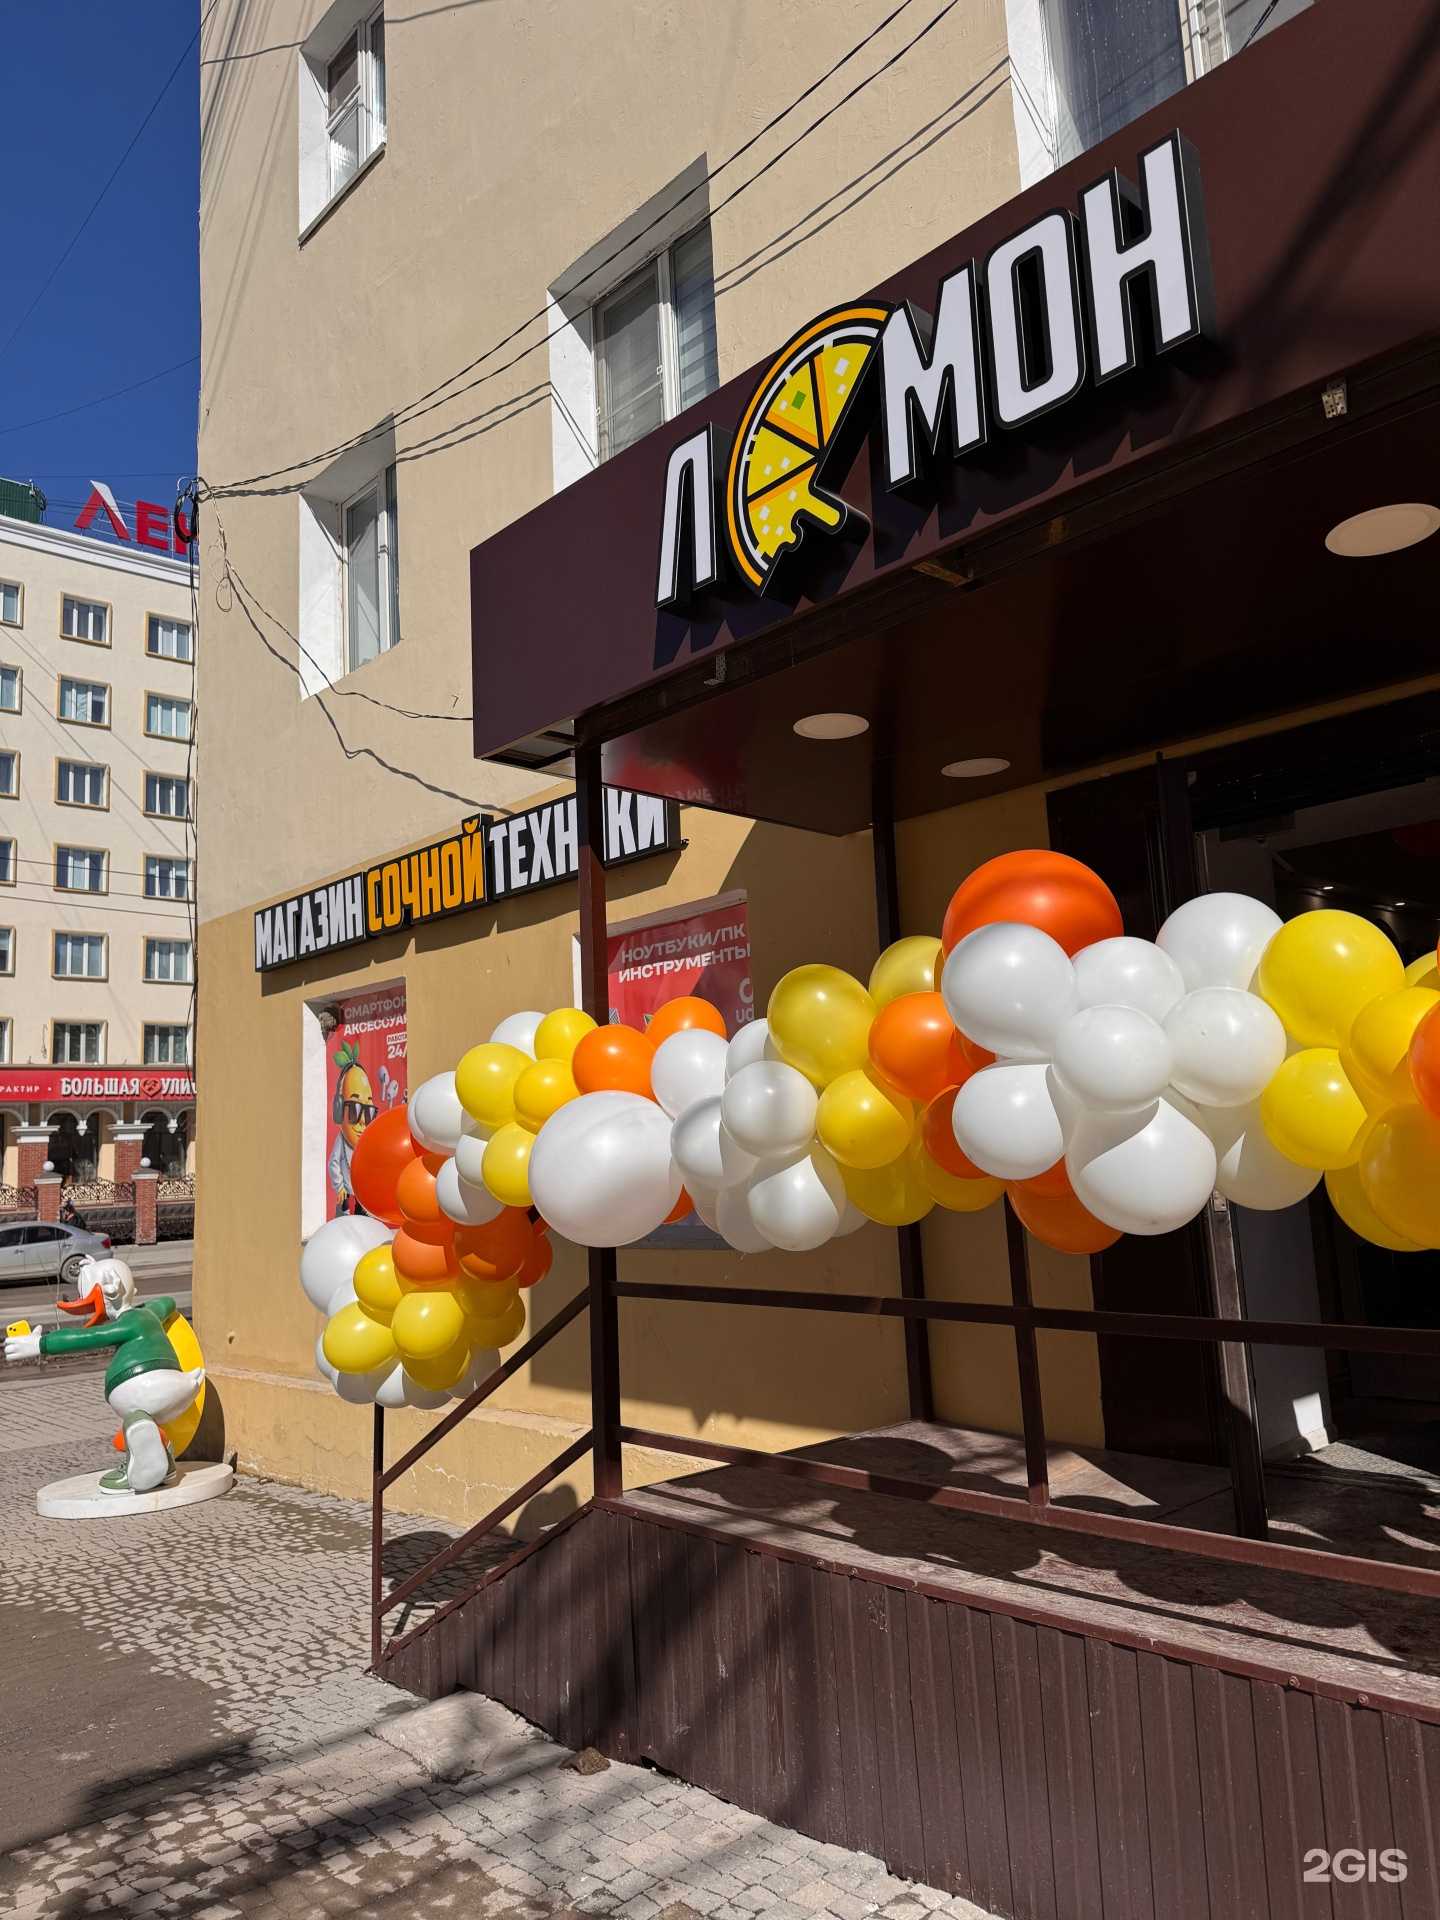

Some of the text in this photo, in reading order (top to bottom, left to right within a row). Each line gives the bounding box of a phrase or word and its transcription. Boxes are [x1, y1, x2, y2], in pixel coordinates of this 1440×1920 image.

[255, 787, 665, 969] МАГАЗИН СОЧНОЙ ТЕХНКИ
[618, 943, 751, 983] ИНСТРУМЕНТЫ
[622, 923, 746, 963] НОУТБУКИ/ПК
[61, 1077, 140, 1096] БОЛЬШАЯ
